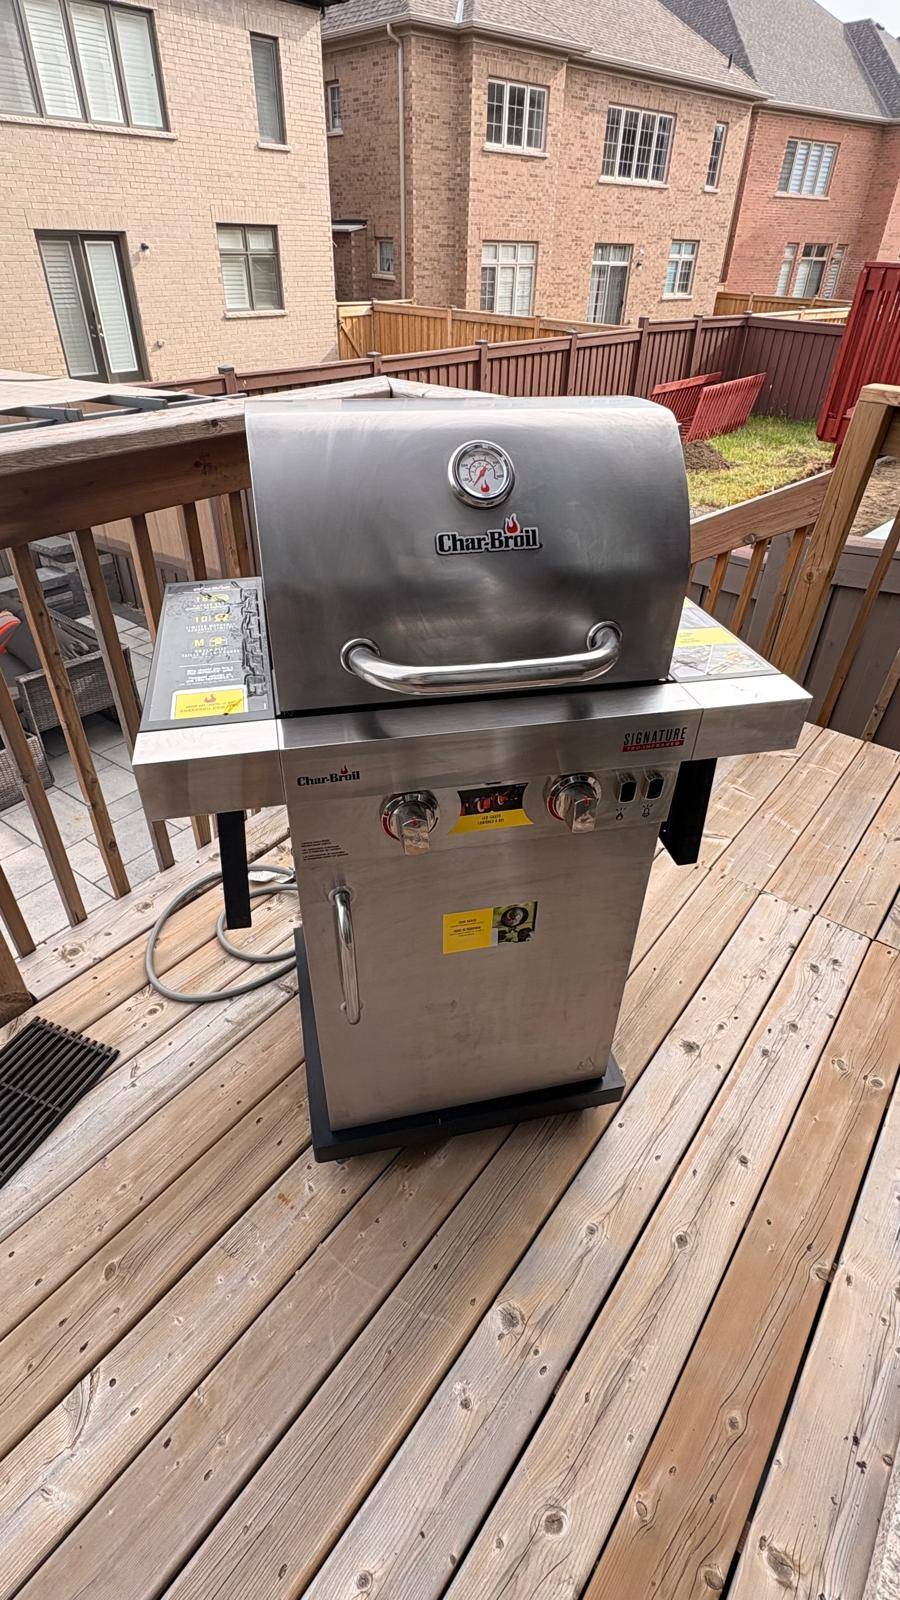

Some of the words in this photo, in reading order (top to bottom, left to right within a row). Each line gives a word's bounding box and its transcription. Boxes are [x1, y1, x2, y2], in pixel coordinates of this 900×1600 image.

[437, 528, 540, 553] Char-Broil
[623, 727, 687, 746] SIGNATURE
[296, 770, 360, 786] Char-Broil
